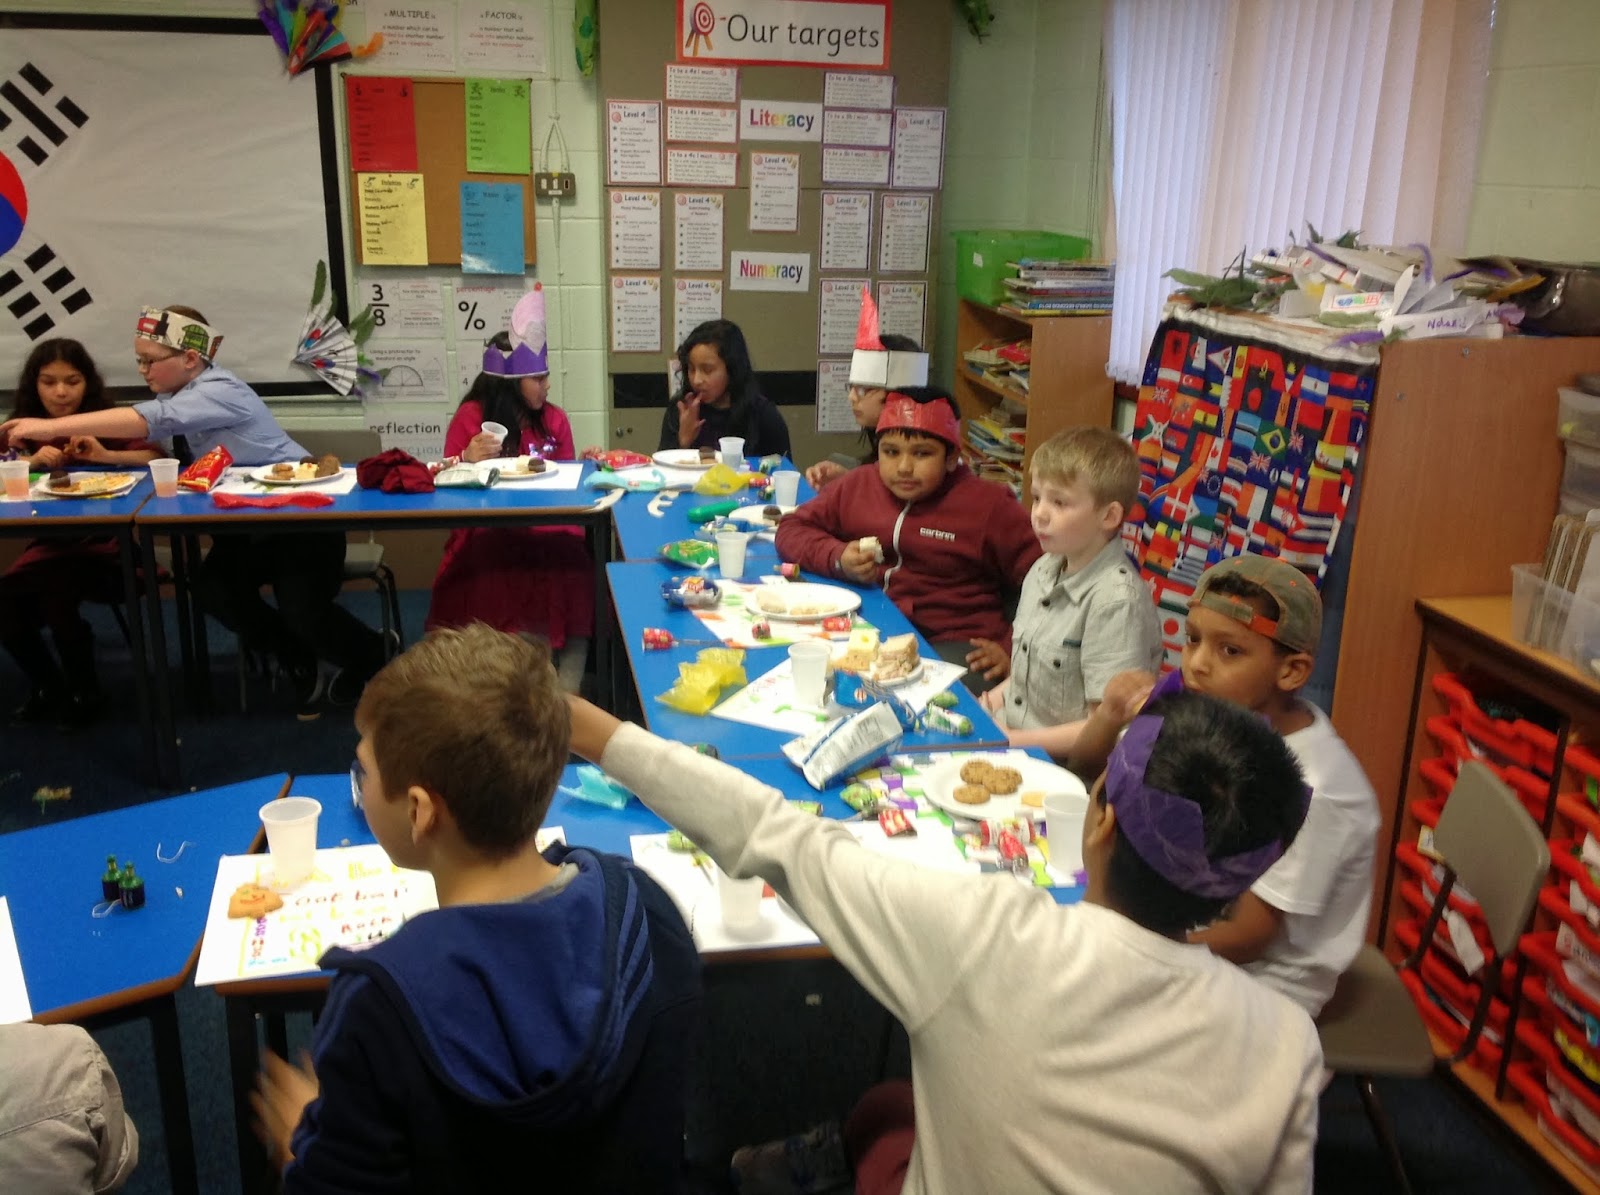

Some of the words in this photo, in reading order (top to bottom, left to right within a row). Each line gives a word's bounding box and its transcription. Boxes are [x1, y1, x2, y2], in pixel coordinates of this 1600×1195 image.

[389, 10, 430, 19] MULTIPLE
[485, 11, 517, 20] FACTOR
[727, 14, 779, 43] Our
[788, 22, 879, 57] targets
[750, 108, 814, 132] Literacy
[688, 196, 704, 204] Level
[740, 259, 803, 284] Numeracy
[371, 284, 384, 301] 3
[456, 286, 496, 294] percentage
[373, 308, 386, 327] 8
[458, 301, 486, 331] %
[462, 377, 468, 386] 4
[370, 421, 441, 434] reflection
